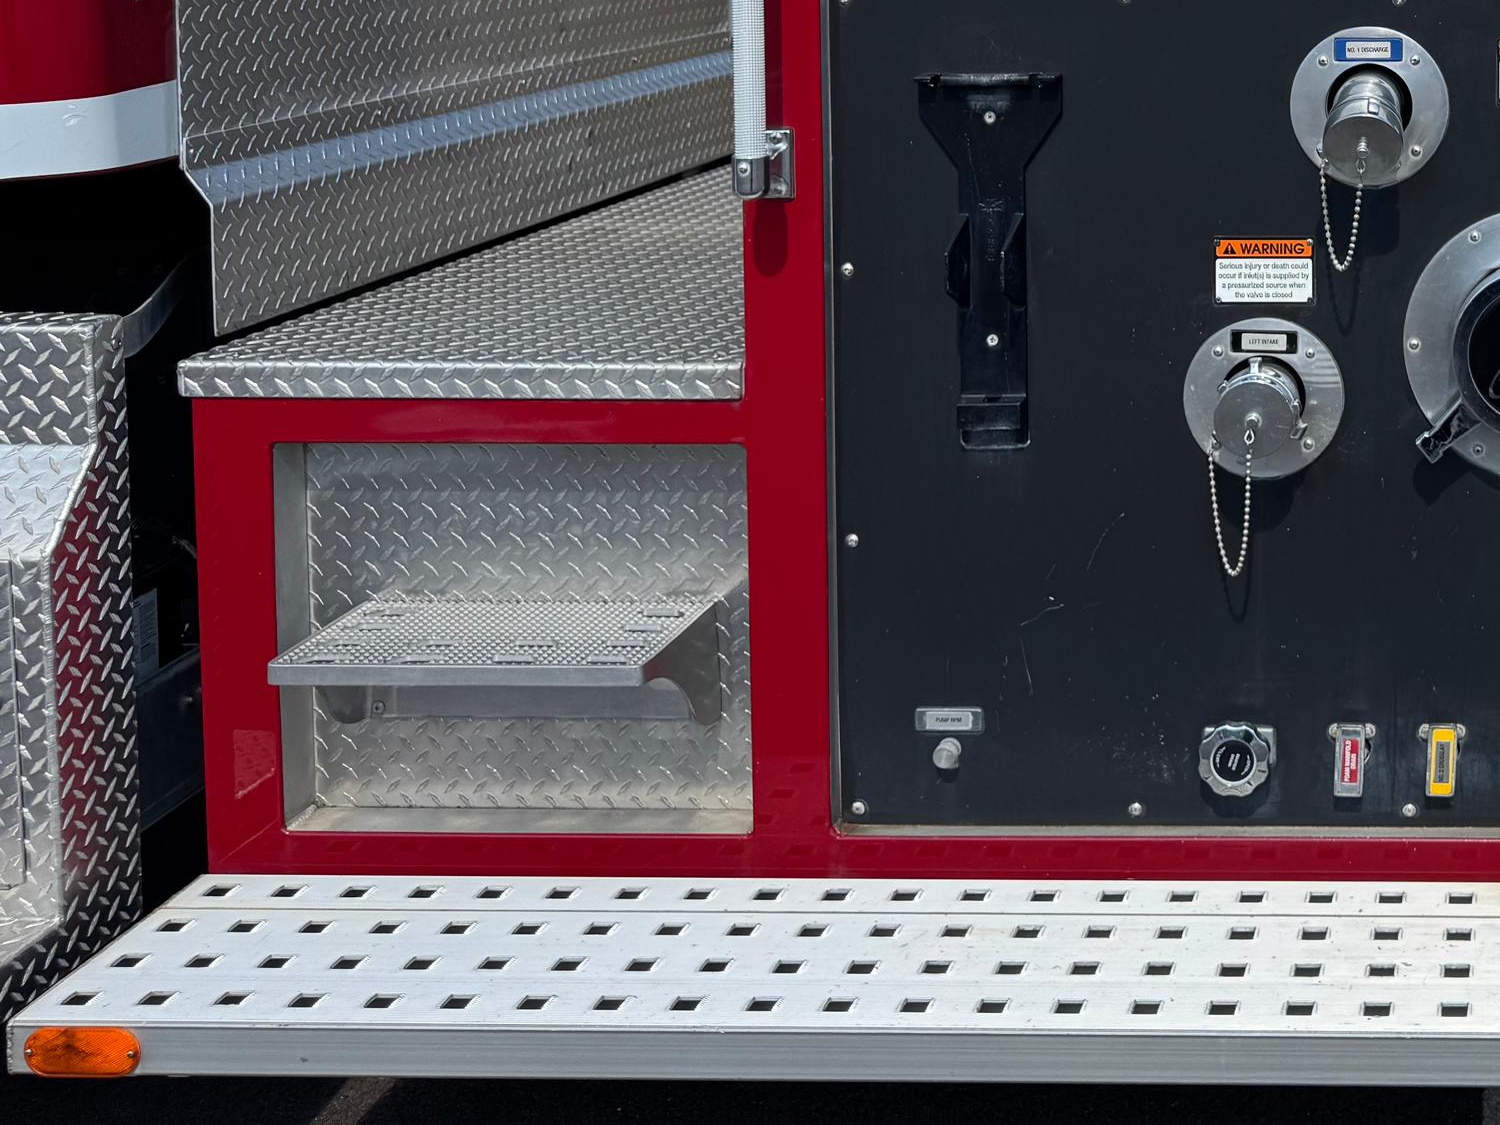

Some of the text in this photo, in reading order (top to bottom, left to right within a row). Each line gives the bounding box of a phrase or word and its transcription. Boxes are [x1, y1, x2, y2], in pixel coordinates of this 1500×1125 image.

[1240, 243, 1305, 255] WARNING
[1244, 262, 1261, 270] injury
[1273, 272, 1299, 280] supplied
[1301, 272, 1309, 280] by
[1228, 282, 1264, 290] pressurized
